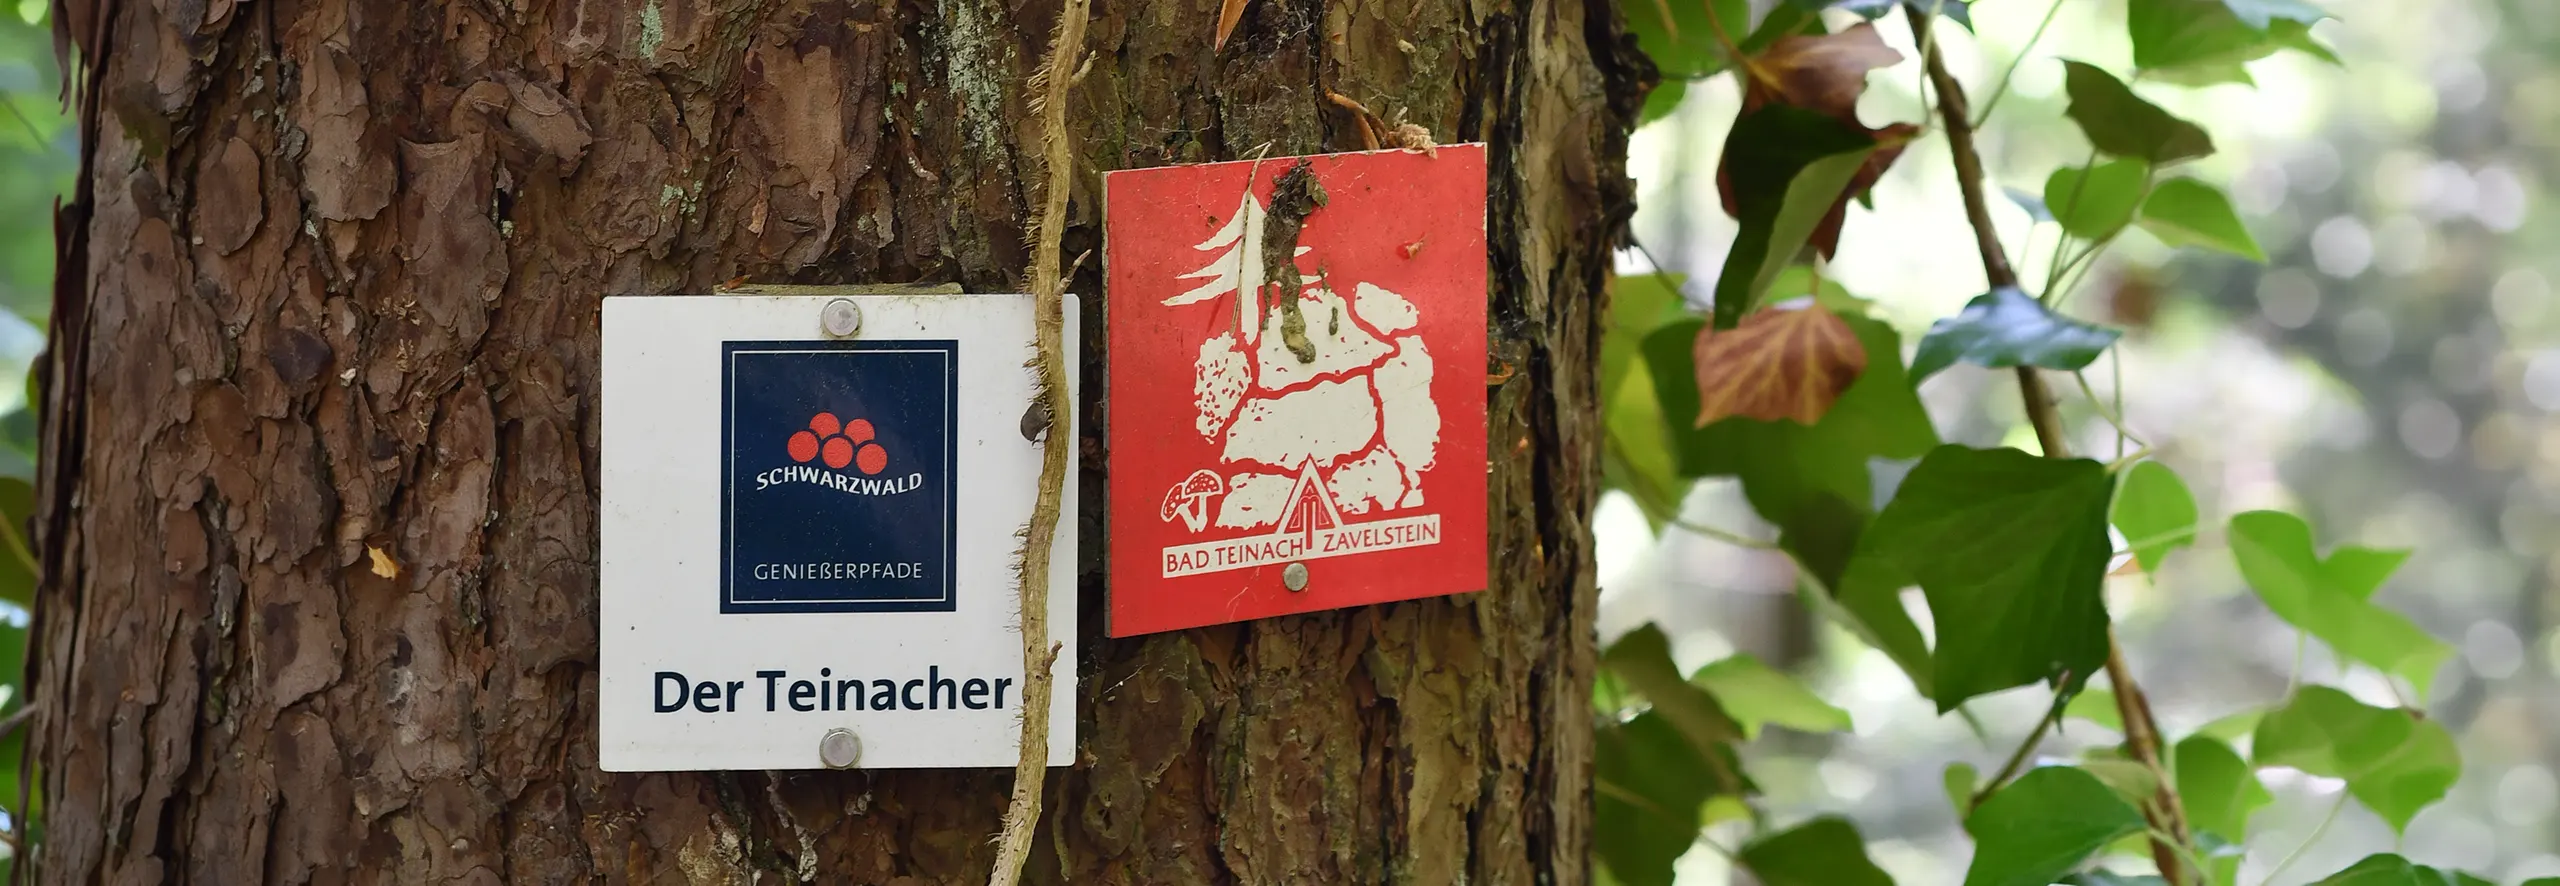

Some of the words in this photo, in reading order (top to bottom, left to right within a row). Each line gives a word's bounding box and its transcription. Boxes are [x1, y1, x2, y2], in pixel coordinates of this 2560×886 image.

[756, 465, 922, 496] SCHWARZWALD
[1166, 549, 1209, 573] BAD
[1216, 536, 1304, 566] TEINACH
[1323, 522, 1438, 552] ZAVELSTEIN
[754, 562, 923, 581] GENIEßERPFADE
[654, 671, 744, 713] Der
[756, 665, 1012, 712] Teinacher
